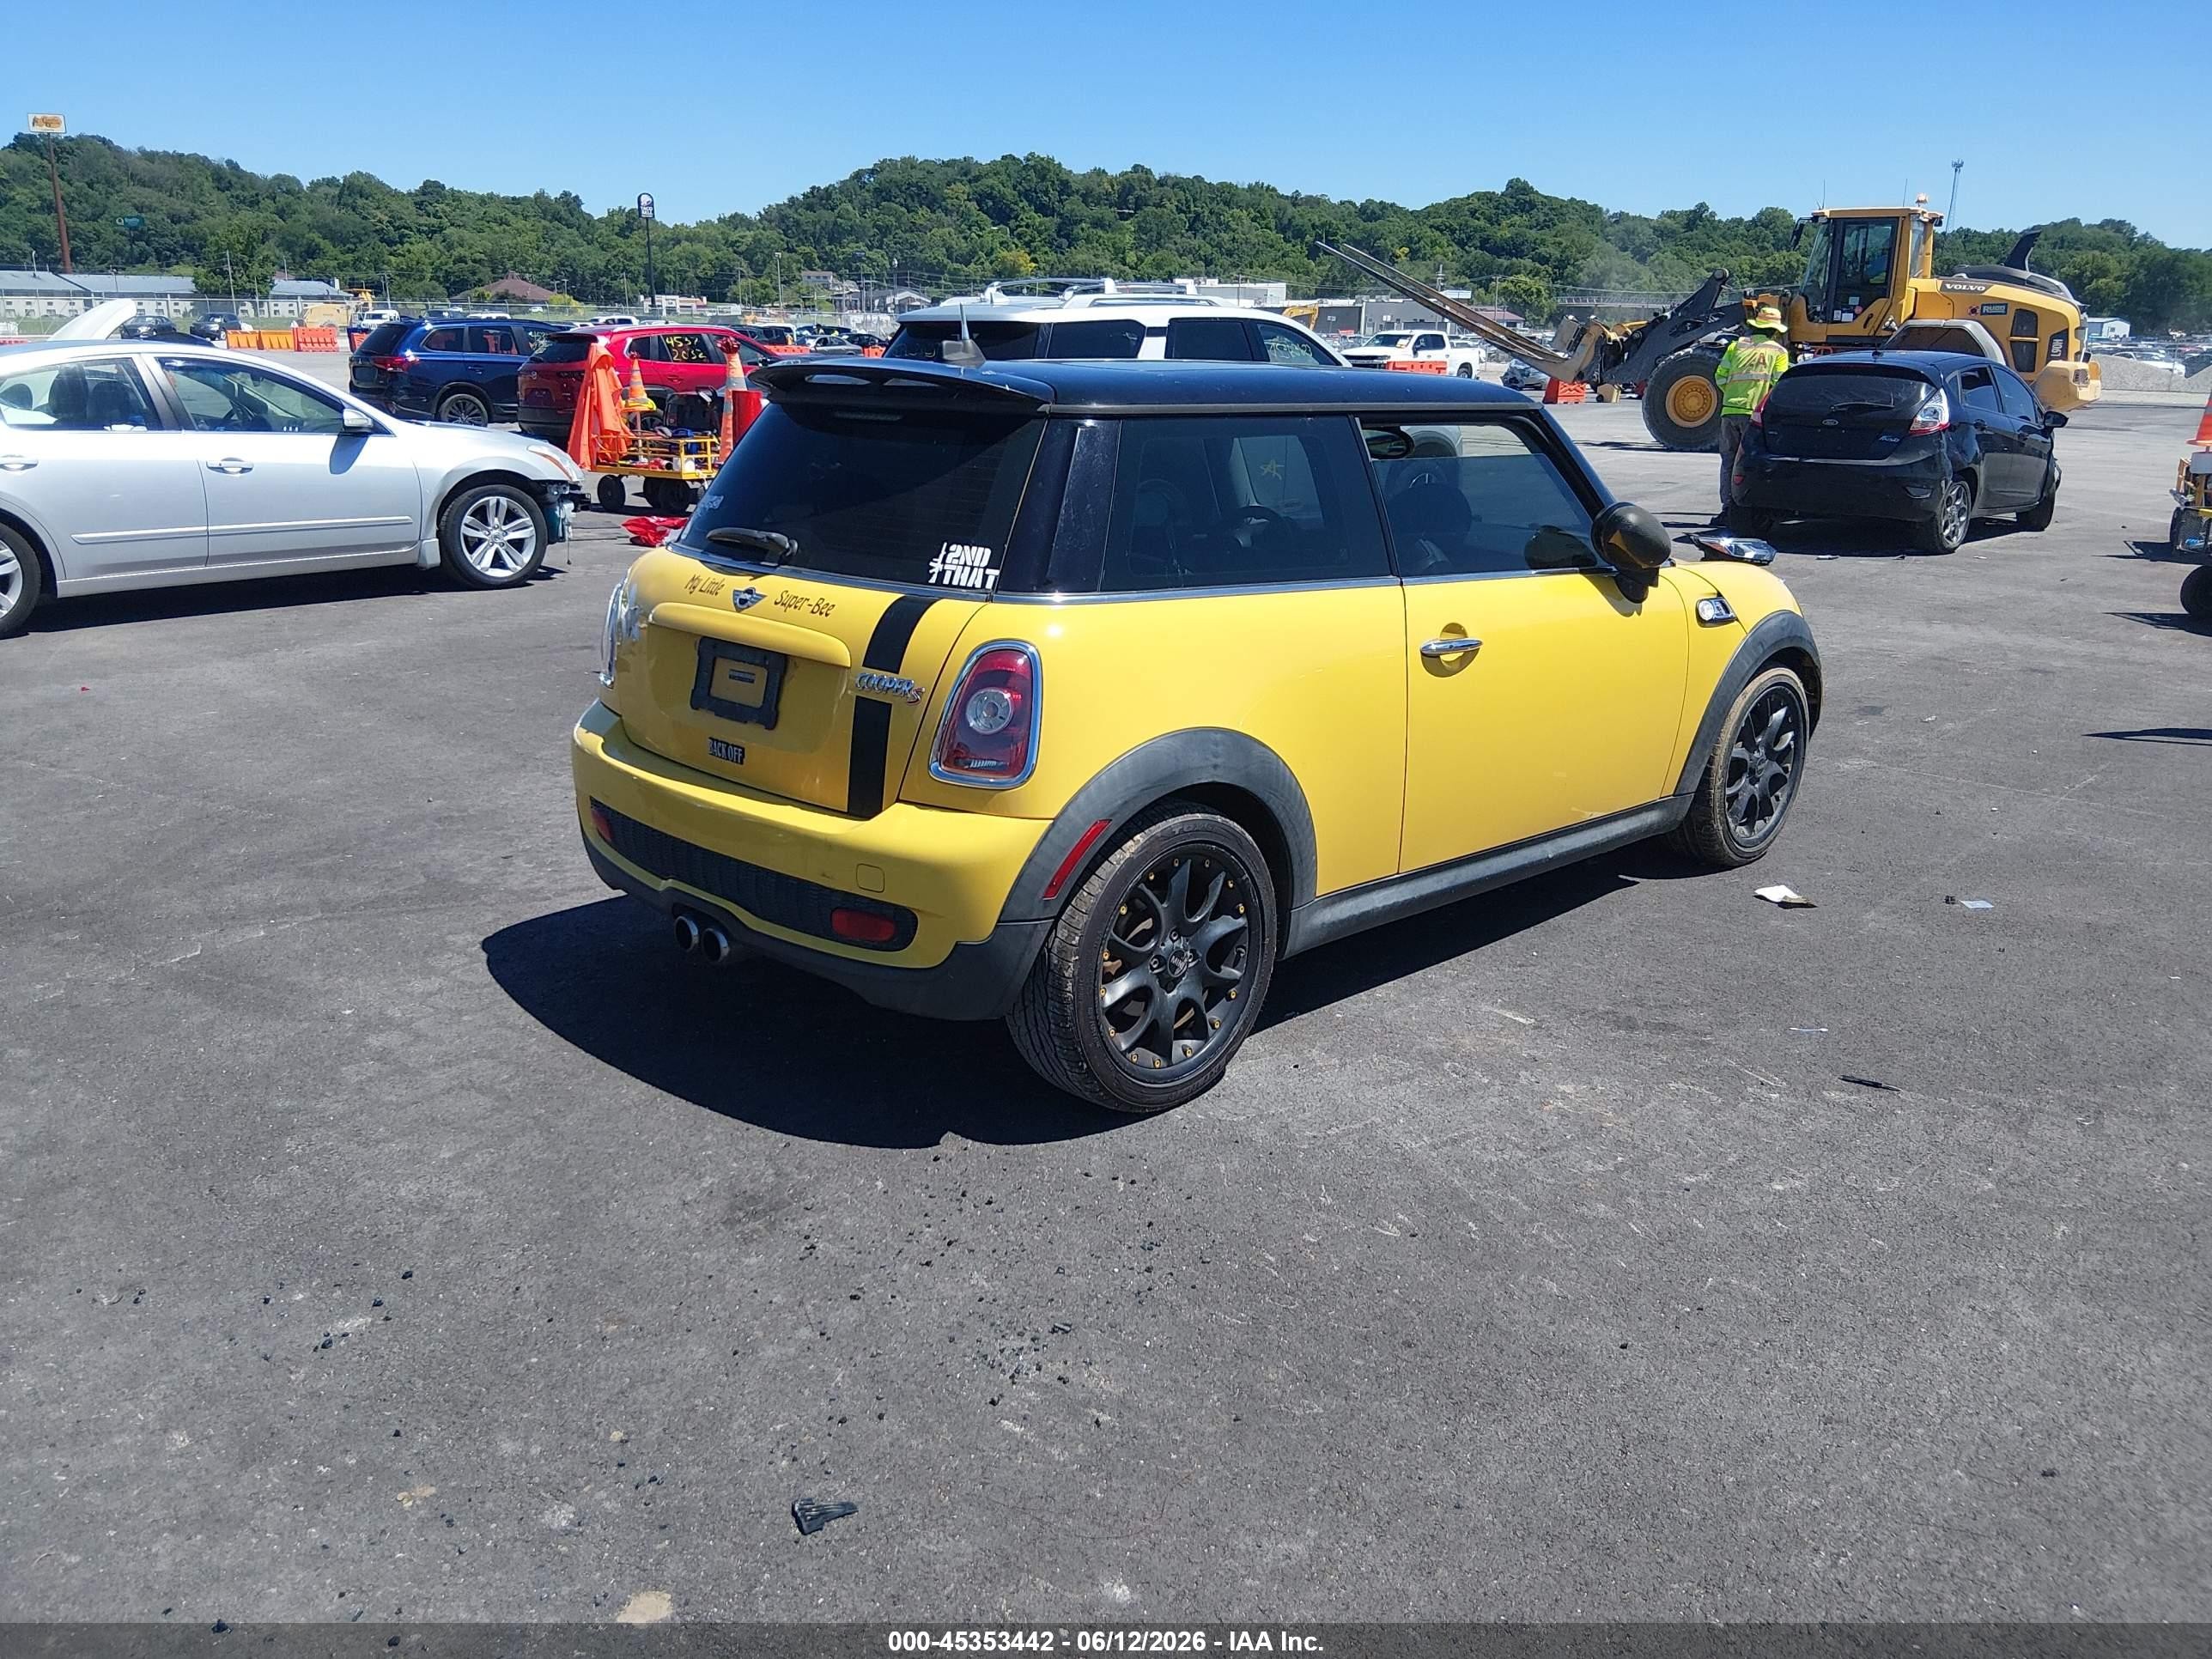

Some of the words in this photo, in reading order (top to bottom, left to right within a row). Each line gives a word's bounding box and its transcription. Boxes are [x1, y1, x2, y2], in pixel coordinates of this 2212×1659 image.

[2051, 338, 2063, 357] L90H
[945, 544, 992, 567] 2ND
[684, 574, 699, 594] My
[699, 577, 725, 596] Little
[943, 563, 1000, 590] THAT
[774, 590, 836, 617] Super-Bee
[855, 672, 915, 697] COOPER
[907, 687, 926, 706] S
[708, 739, 727, 759] BACK
[727, 745, 743, 763] OFF
